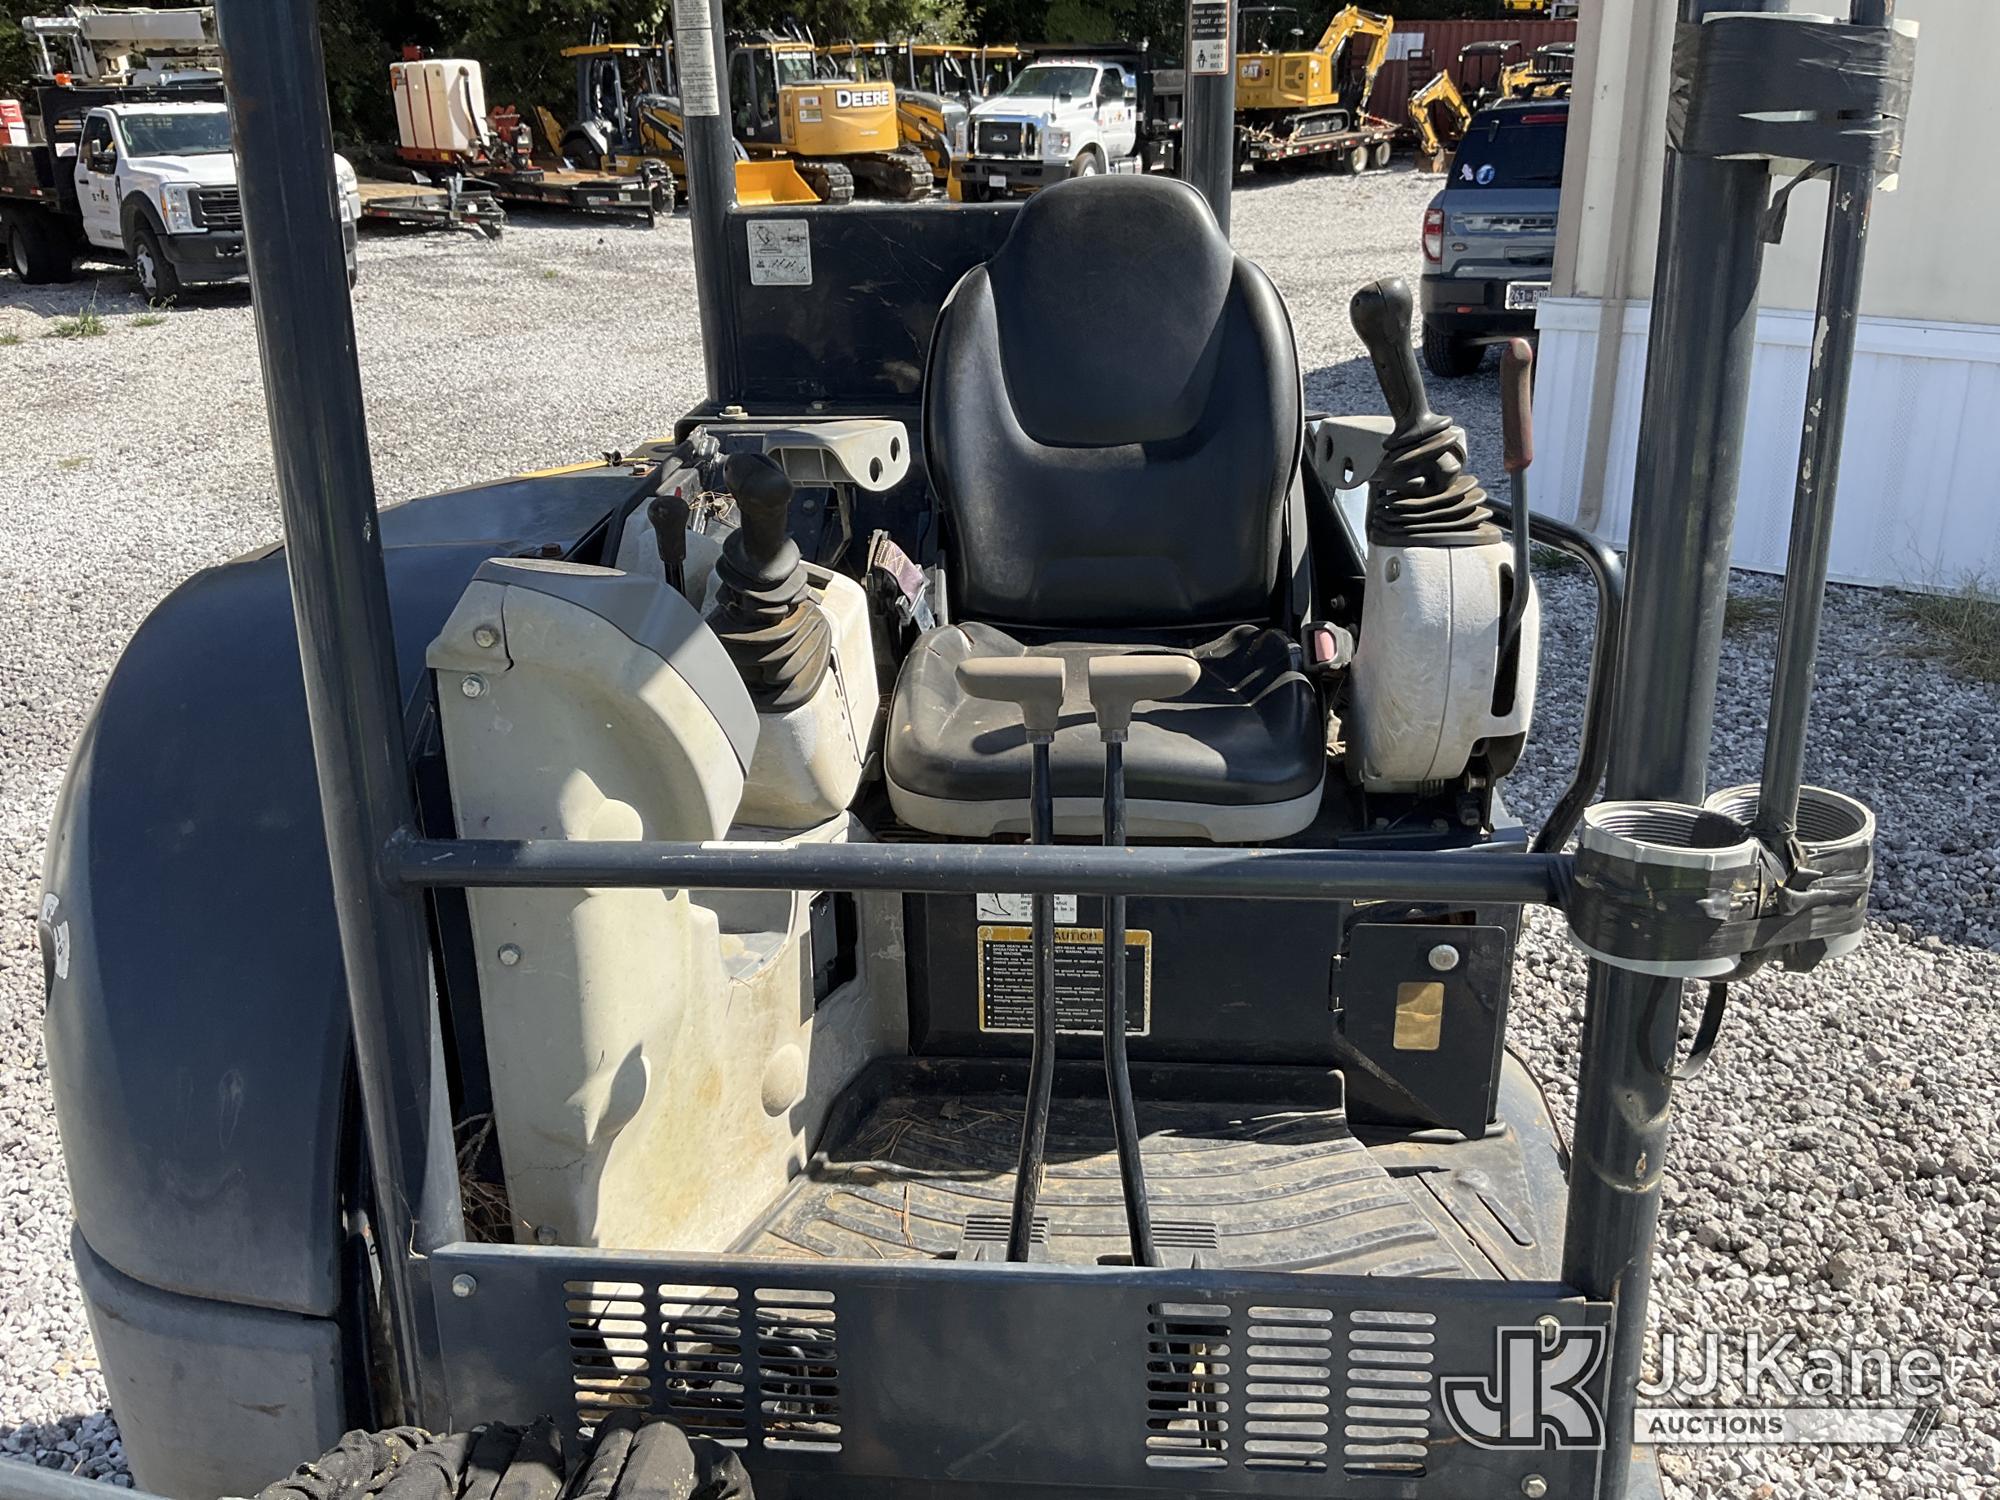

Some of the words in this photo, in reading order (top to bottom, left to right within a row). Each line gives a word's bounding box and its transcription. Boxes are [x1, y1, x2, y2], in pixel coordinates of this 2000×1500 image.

[1241, 64, 1260, 78] CAT
[835, 89, 889, 108] DEERE
[1509, 290, 1526, 303] 263
[1054, 931, 1097, 941] AUTION
